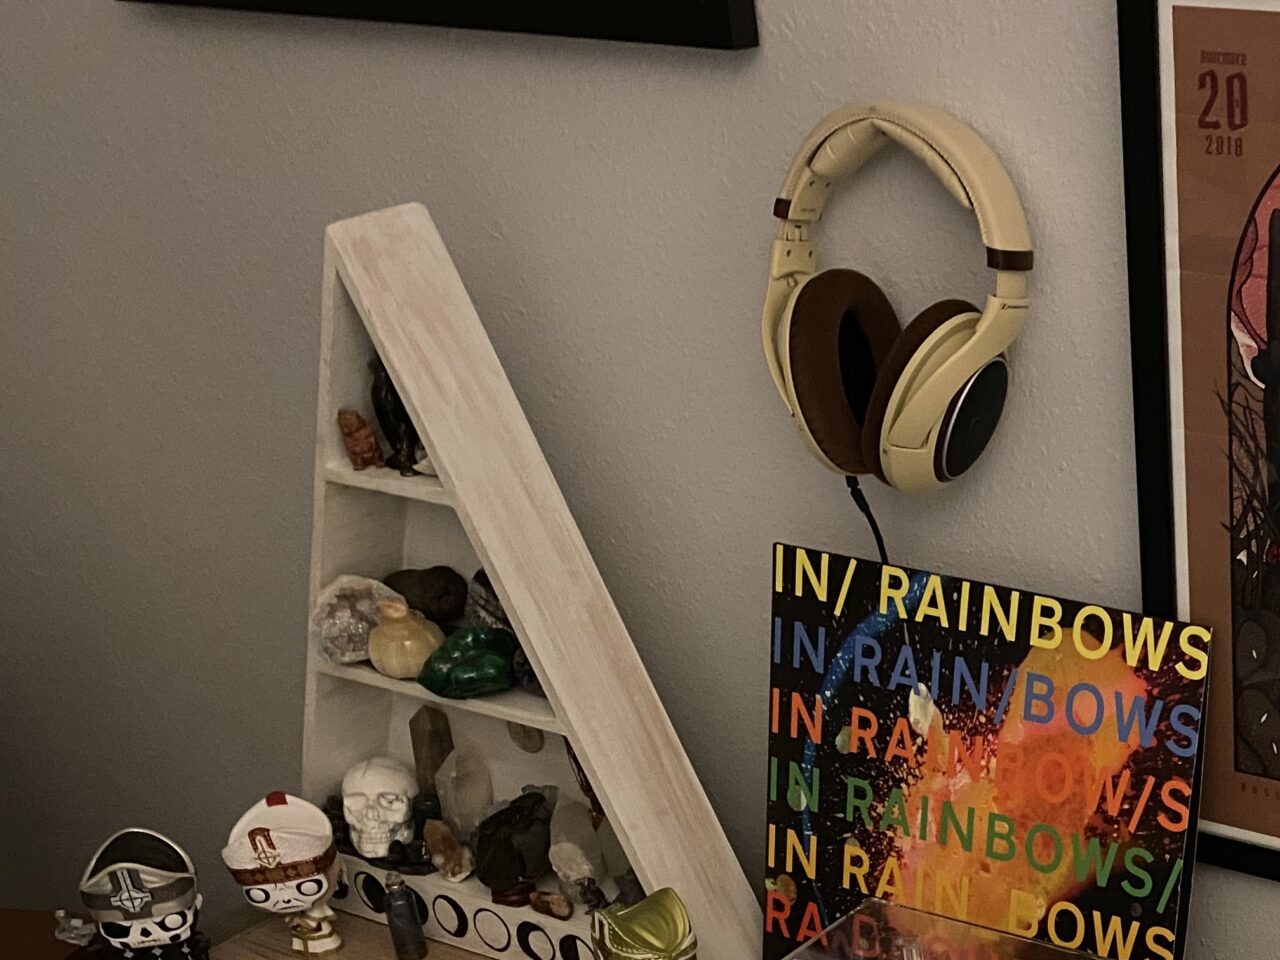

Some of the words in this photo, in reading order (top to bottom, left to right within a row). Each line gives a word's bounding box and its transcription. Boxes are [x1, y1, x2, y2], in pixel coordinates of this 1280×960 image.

[1198, 69, 1248, 130] 20
[1205, 134, 1243, 157] 2018
[775, 543, 858, 617] IN/
[880, 565, 1212, 681] RAINBOWS
[773, 617, 826, 674] IN
[854, 637, 1201, 757] RAIN/BOWS
[771, 687, 823, 745] IN
[850, 707, 1192, 833] RAINBOW/S
[767, 824, 817, 880] IN
[842, 840, 971, 919] RAIN
[769, 757, 820, 814] IN
[845, 777, 1183, 914] RAINBOWS/
